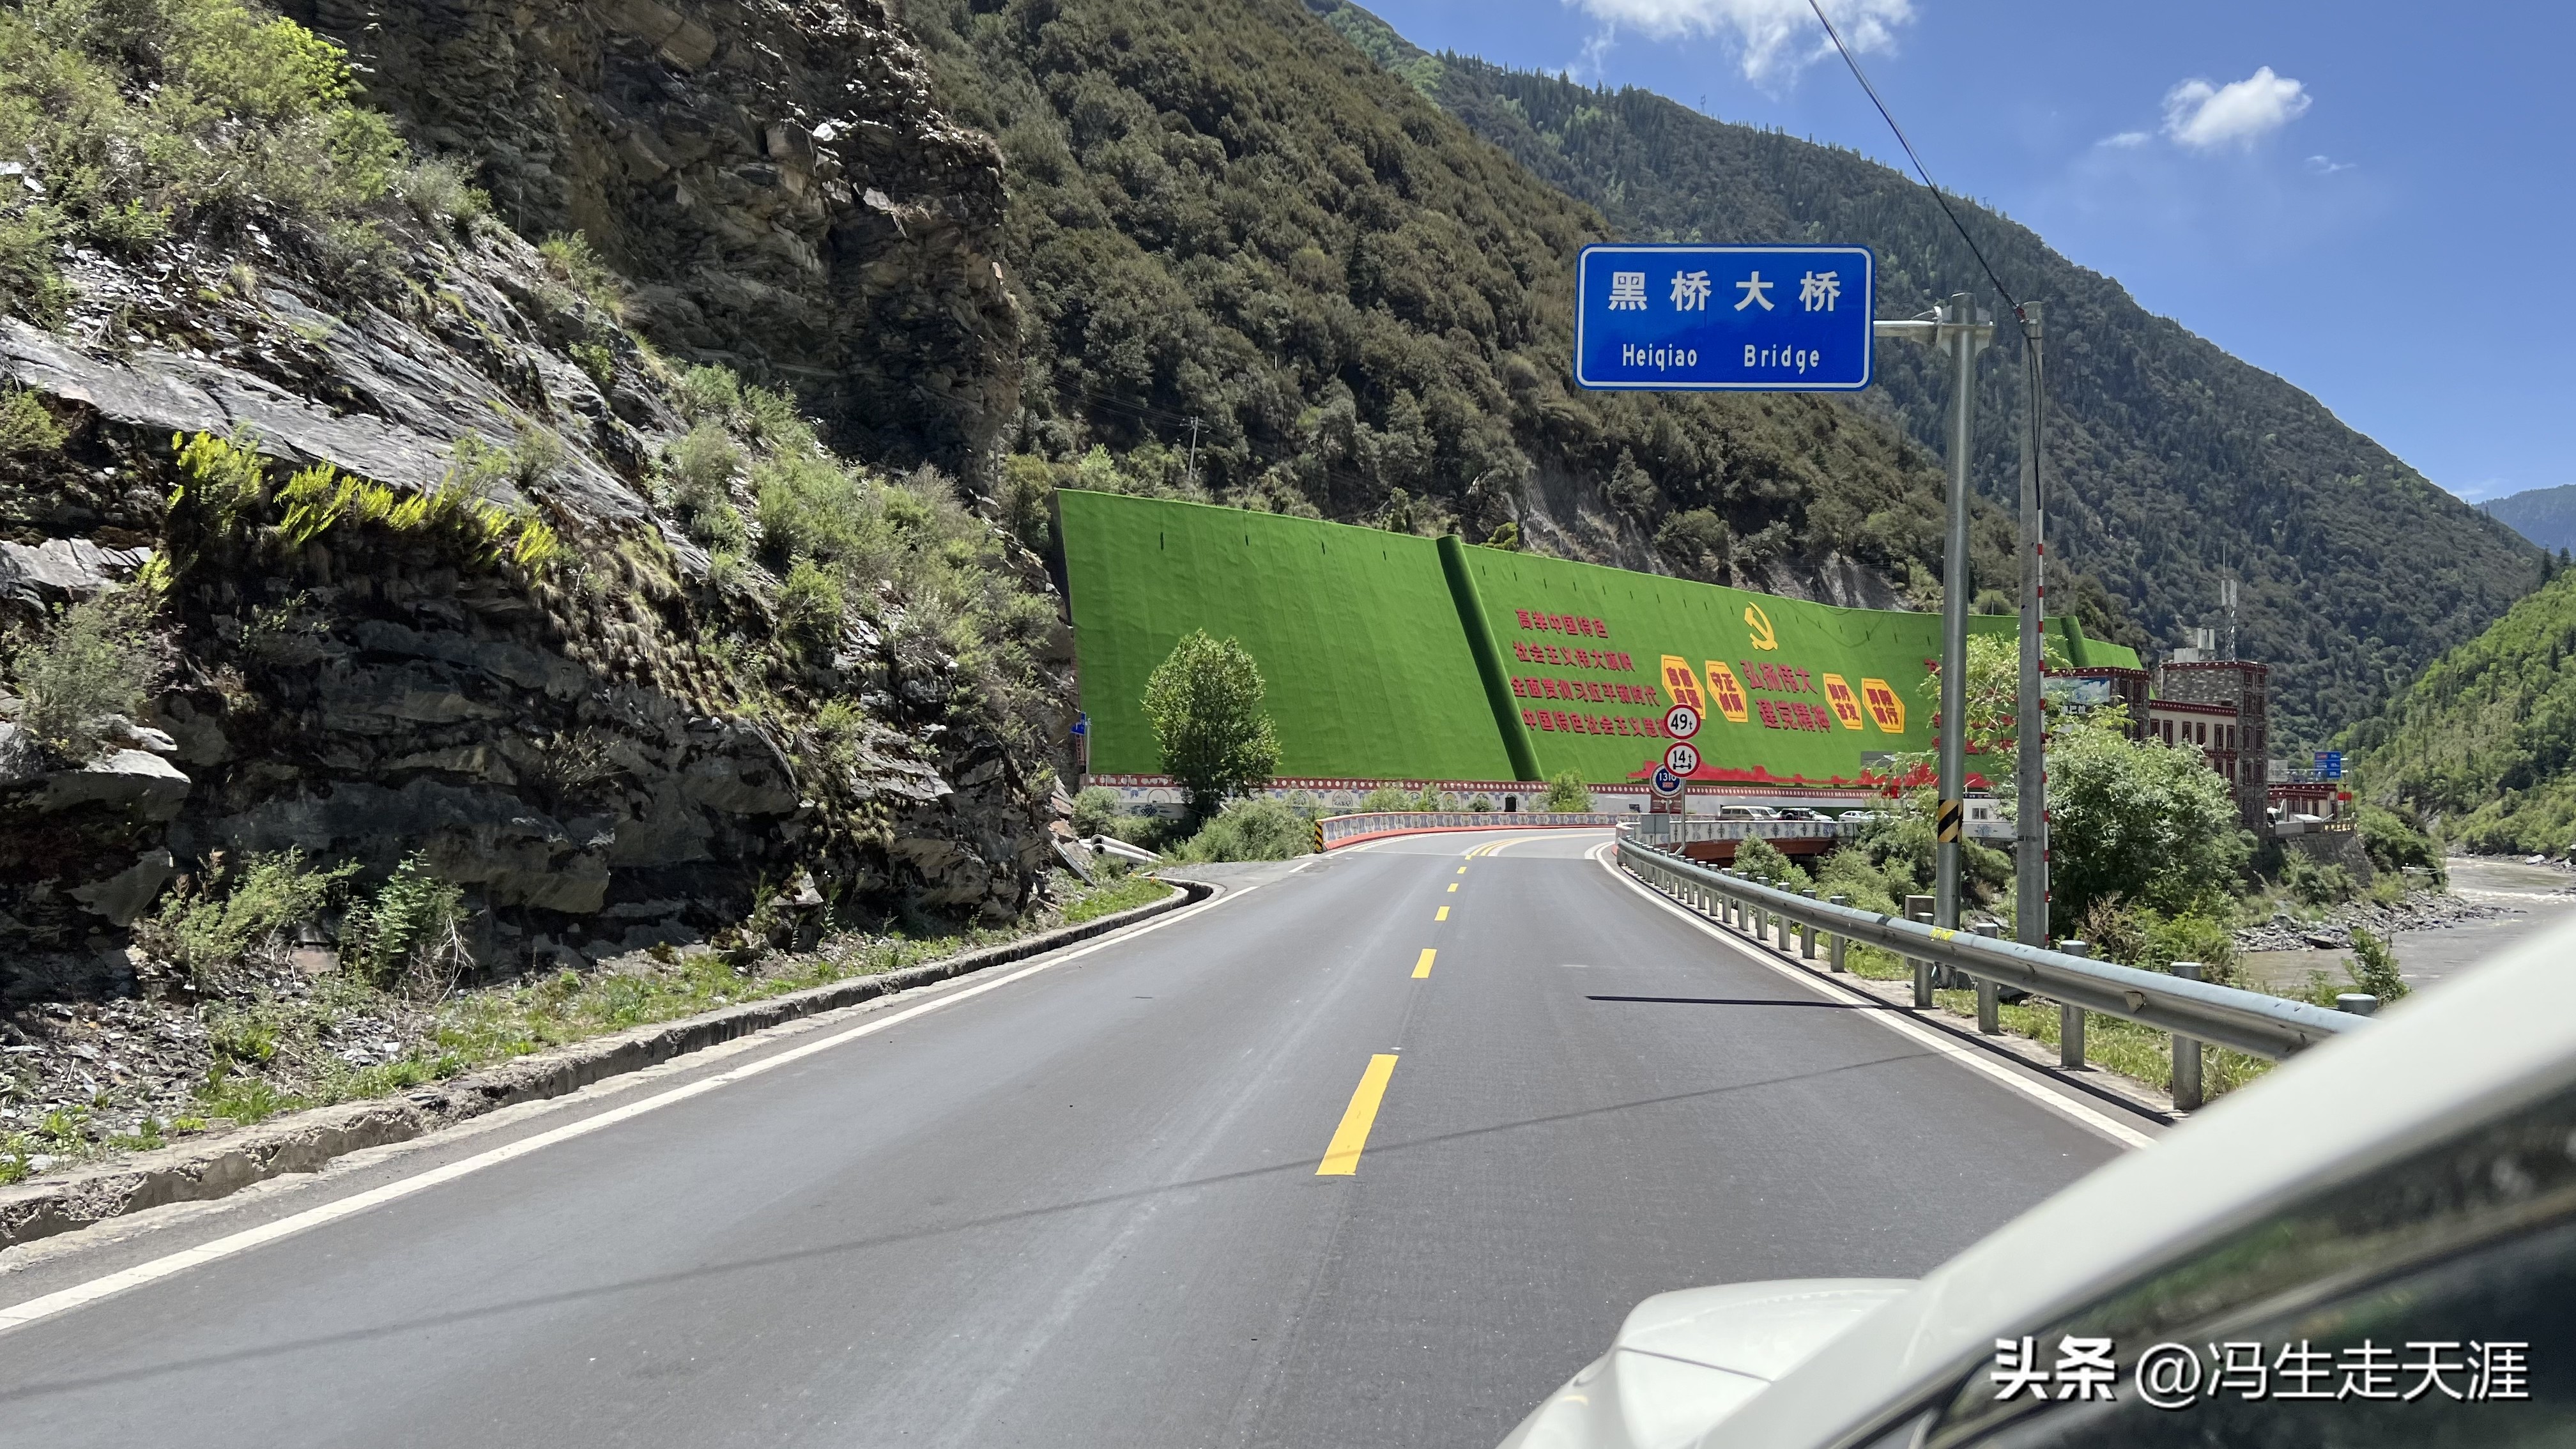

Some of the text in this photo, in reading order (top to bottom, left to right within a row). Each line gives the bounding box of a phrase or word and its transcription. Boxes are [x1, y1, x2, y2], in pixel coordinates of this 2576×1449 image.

[1608, 270, 1841, 312] 黑桥大桥
[1622, 343, 1820, 374] Heiqiao Bridge
[1515, 608, 1608, 638] 高举中国特色
[1513, 640, 1635, 671] 社会主义伟大旗帜
[1510, 675, 1660, 707] 全面贯彻习近平新时代
[1740, 659, 1818, 694] 弘扬伟大
[1670, 714, 1692, 730] 49t
[1755, 698, 1830, 733] 建党精神
[1673, 750, 1692, 763] 14t
